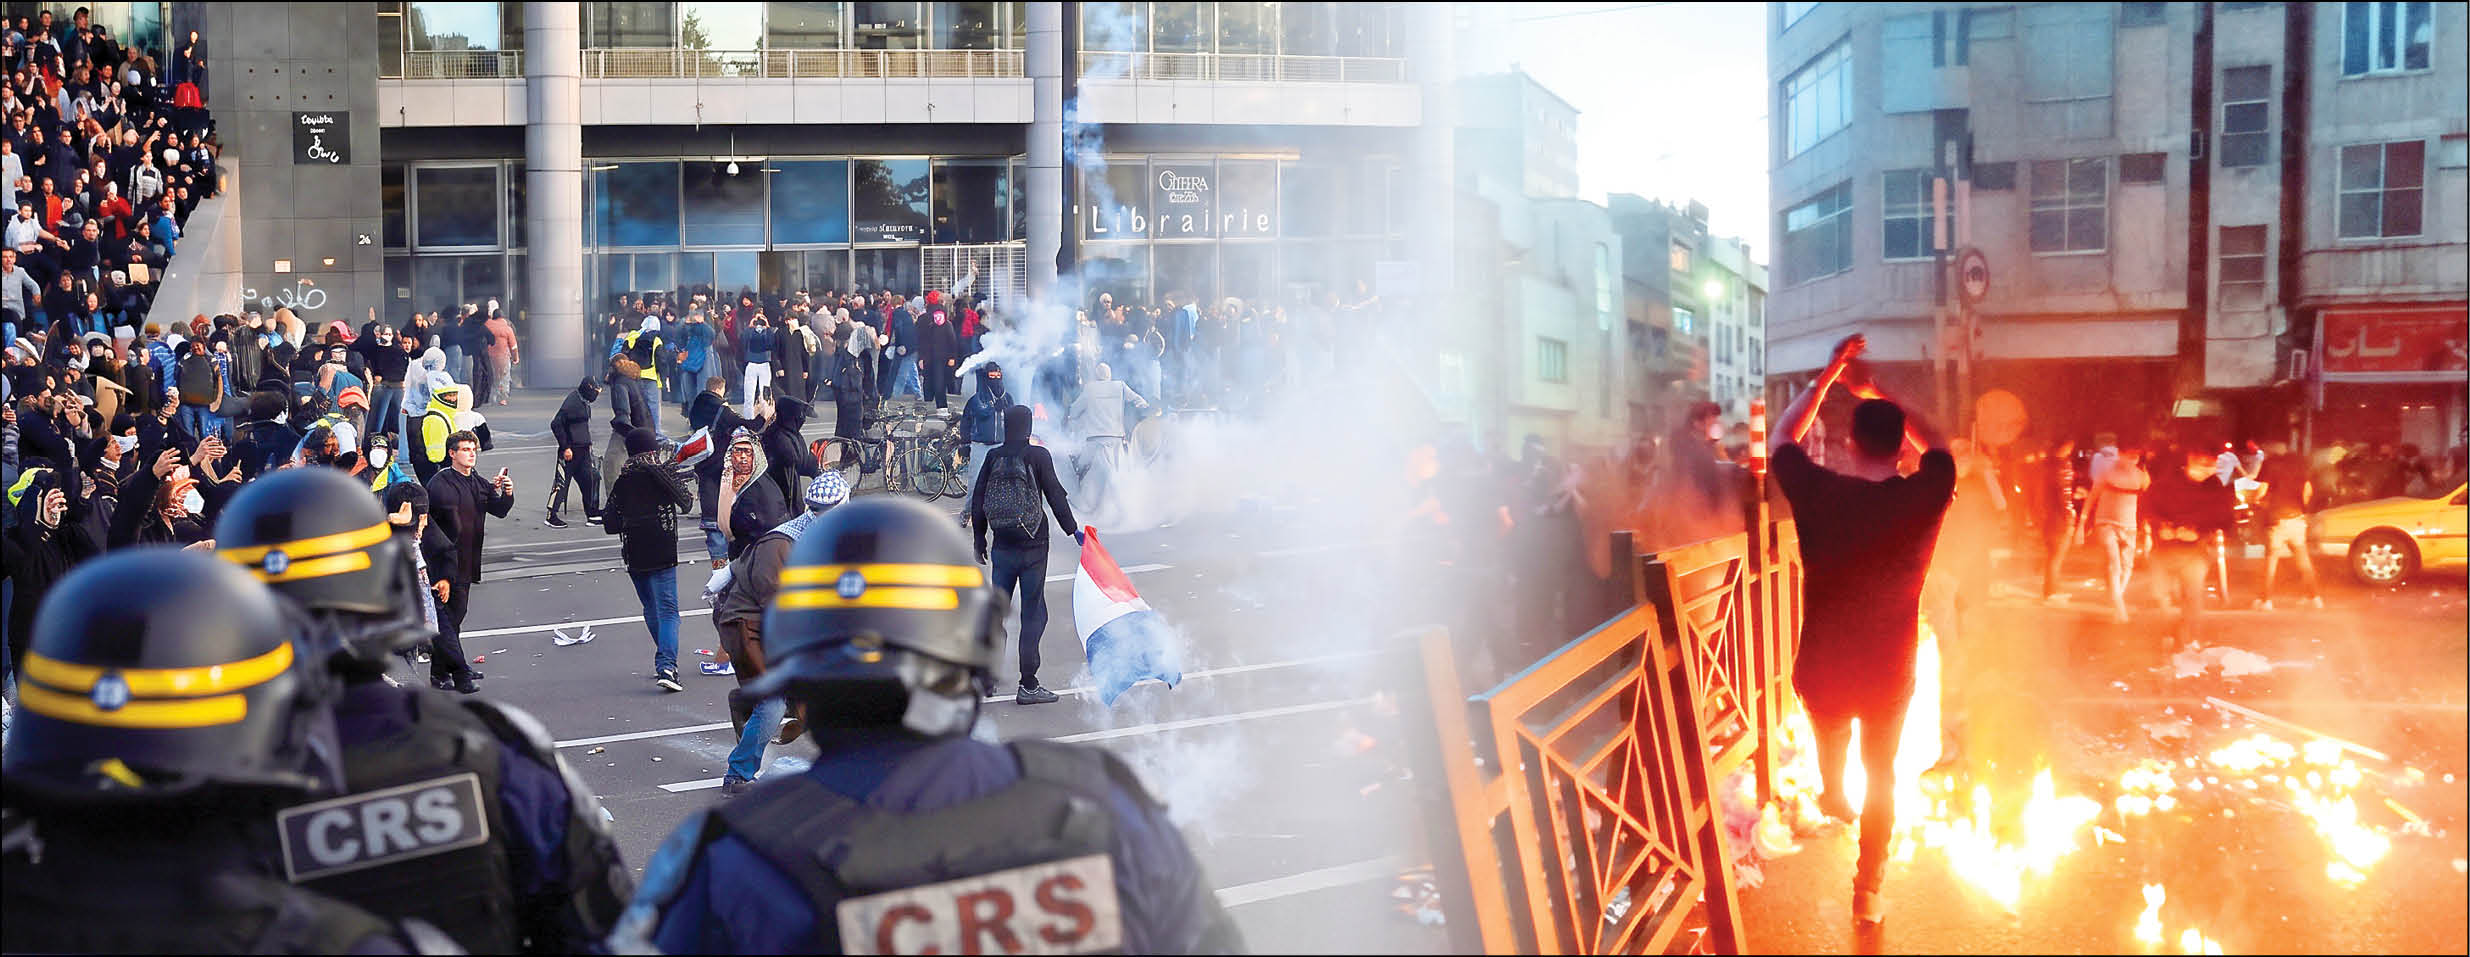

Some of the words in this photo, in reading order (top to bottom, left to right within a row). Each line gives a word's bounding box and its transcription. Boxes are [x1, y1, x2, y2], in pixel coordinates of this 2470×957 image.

[1092, 206, 1271, 233] Librairie
[306, 787, 464, 865] CRS
[876, 874, 1096, 955] CRS
